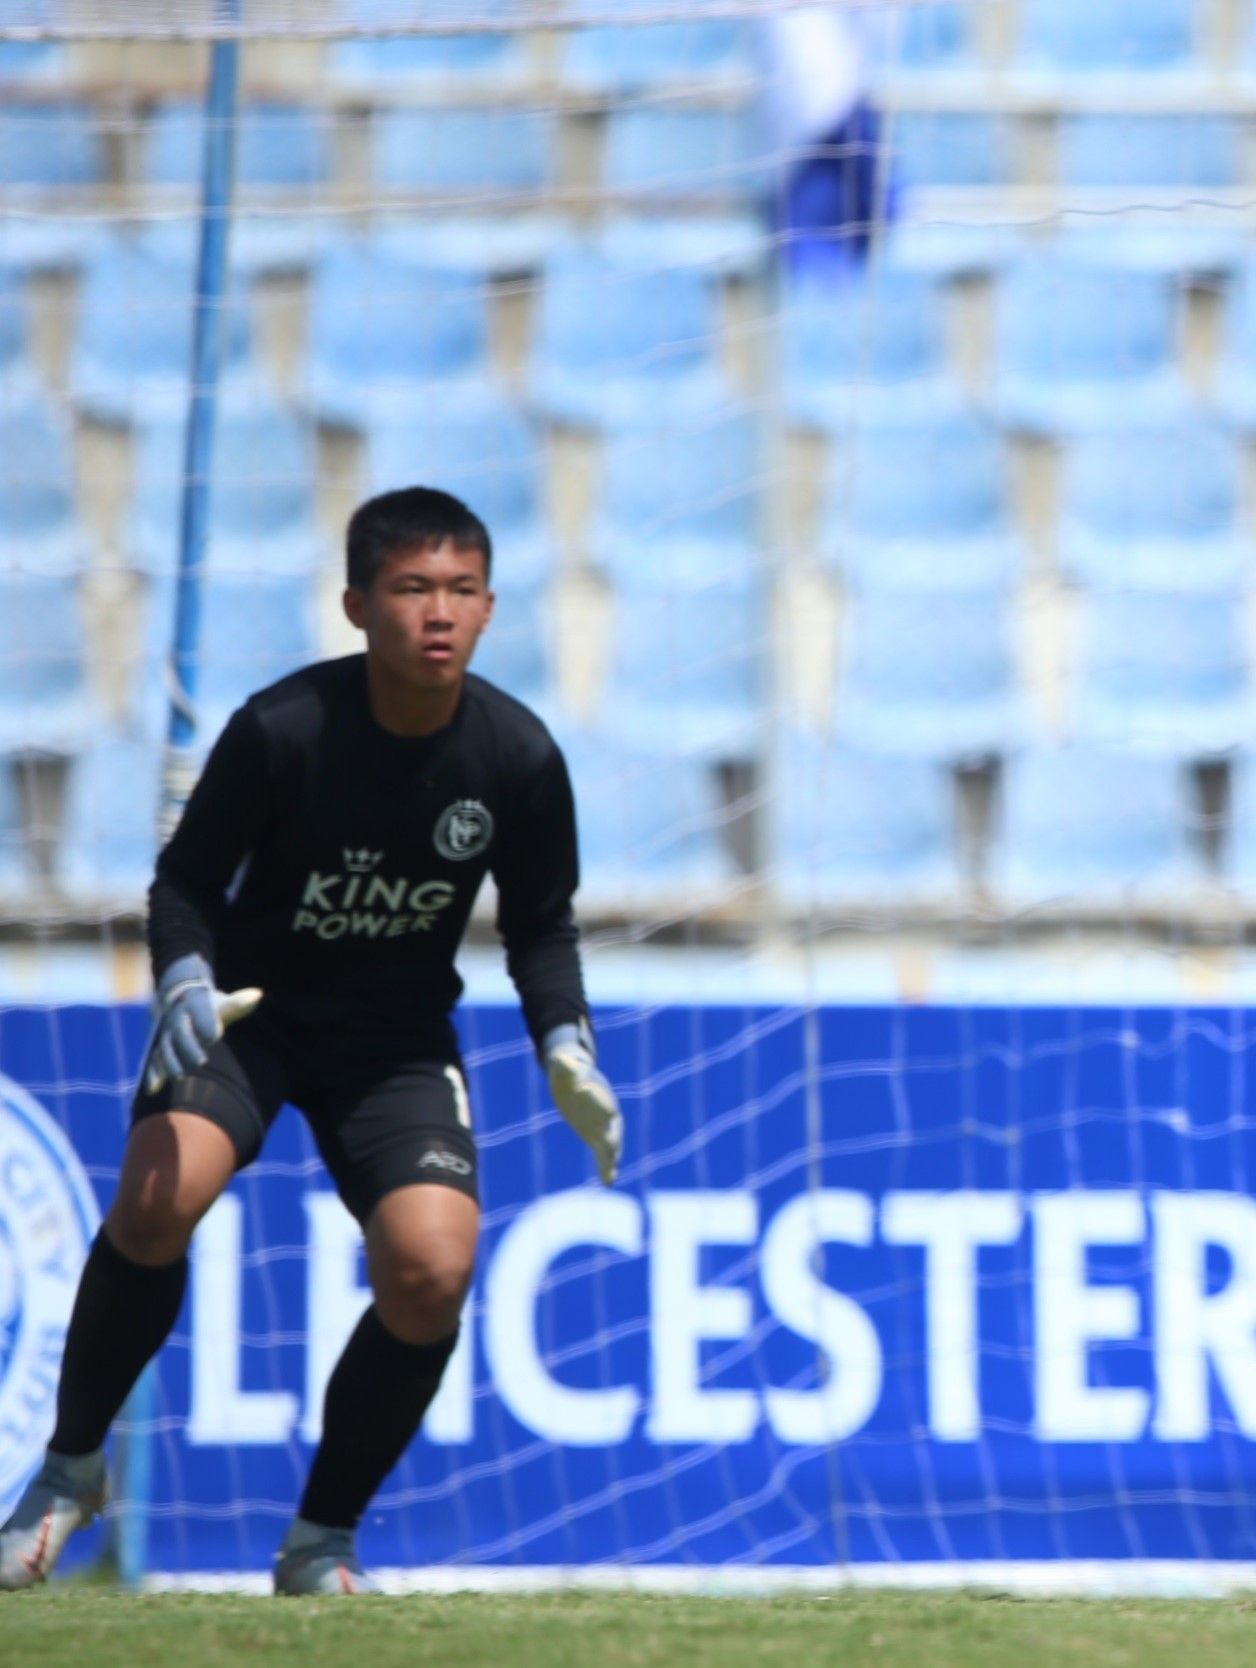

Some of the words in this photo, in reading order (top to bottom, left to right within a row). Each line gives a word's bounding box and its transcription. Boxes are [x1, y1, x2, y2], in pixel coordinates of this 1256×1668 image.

[303, 871, 456, 912] KING
[292, 908, 437, 940] POWER
[443, 1064, 472, 1129] 1
